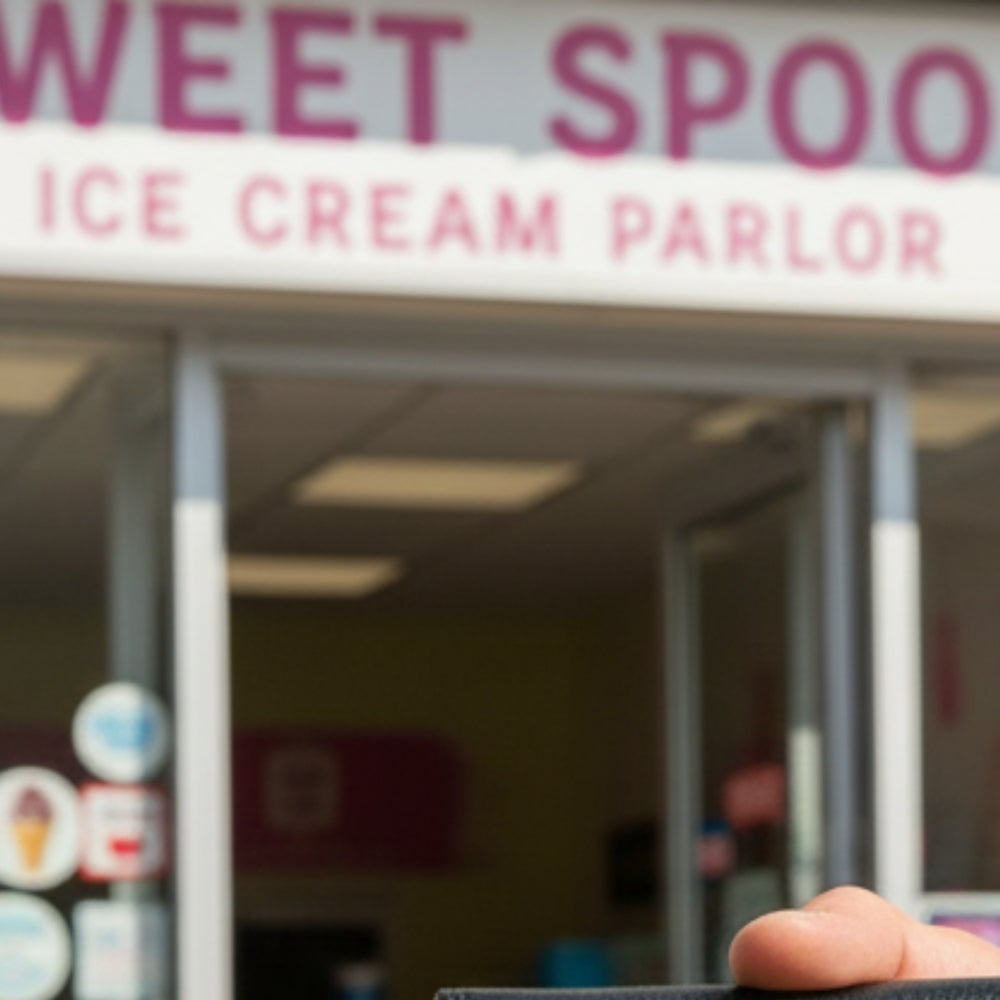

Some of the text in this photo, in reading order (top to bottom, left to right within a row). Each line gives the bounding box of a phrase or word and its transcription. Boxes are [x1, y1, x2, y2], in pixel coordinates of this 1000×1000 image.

[0, 0, 469, 147] WEET
[39, 164, 945, 278] ICE CREAM PARLOR
